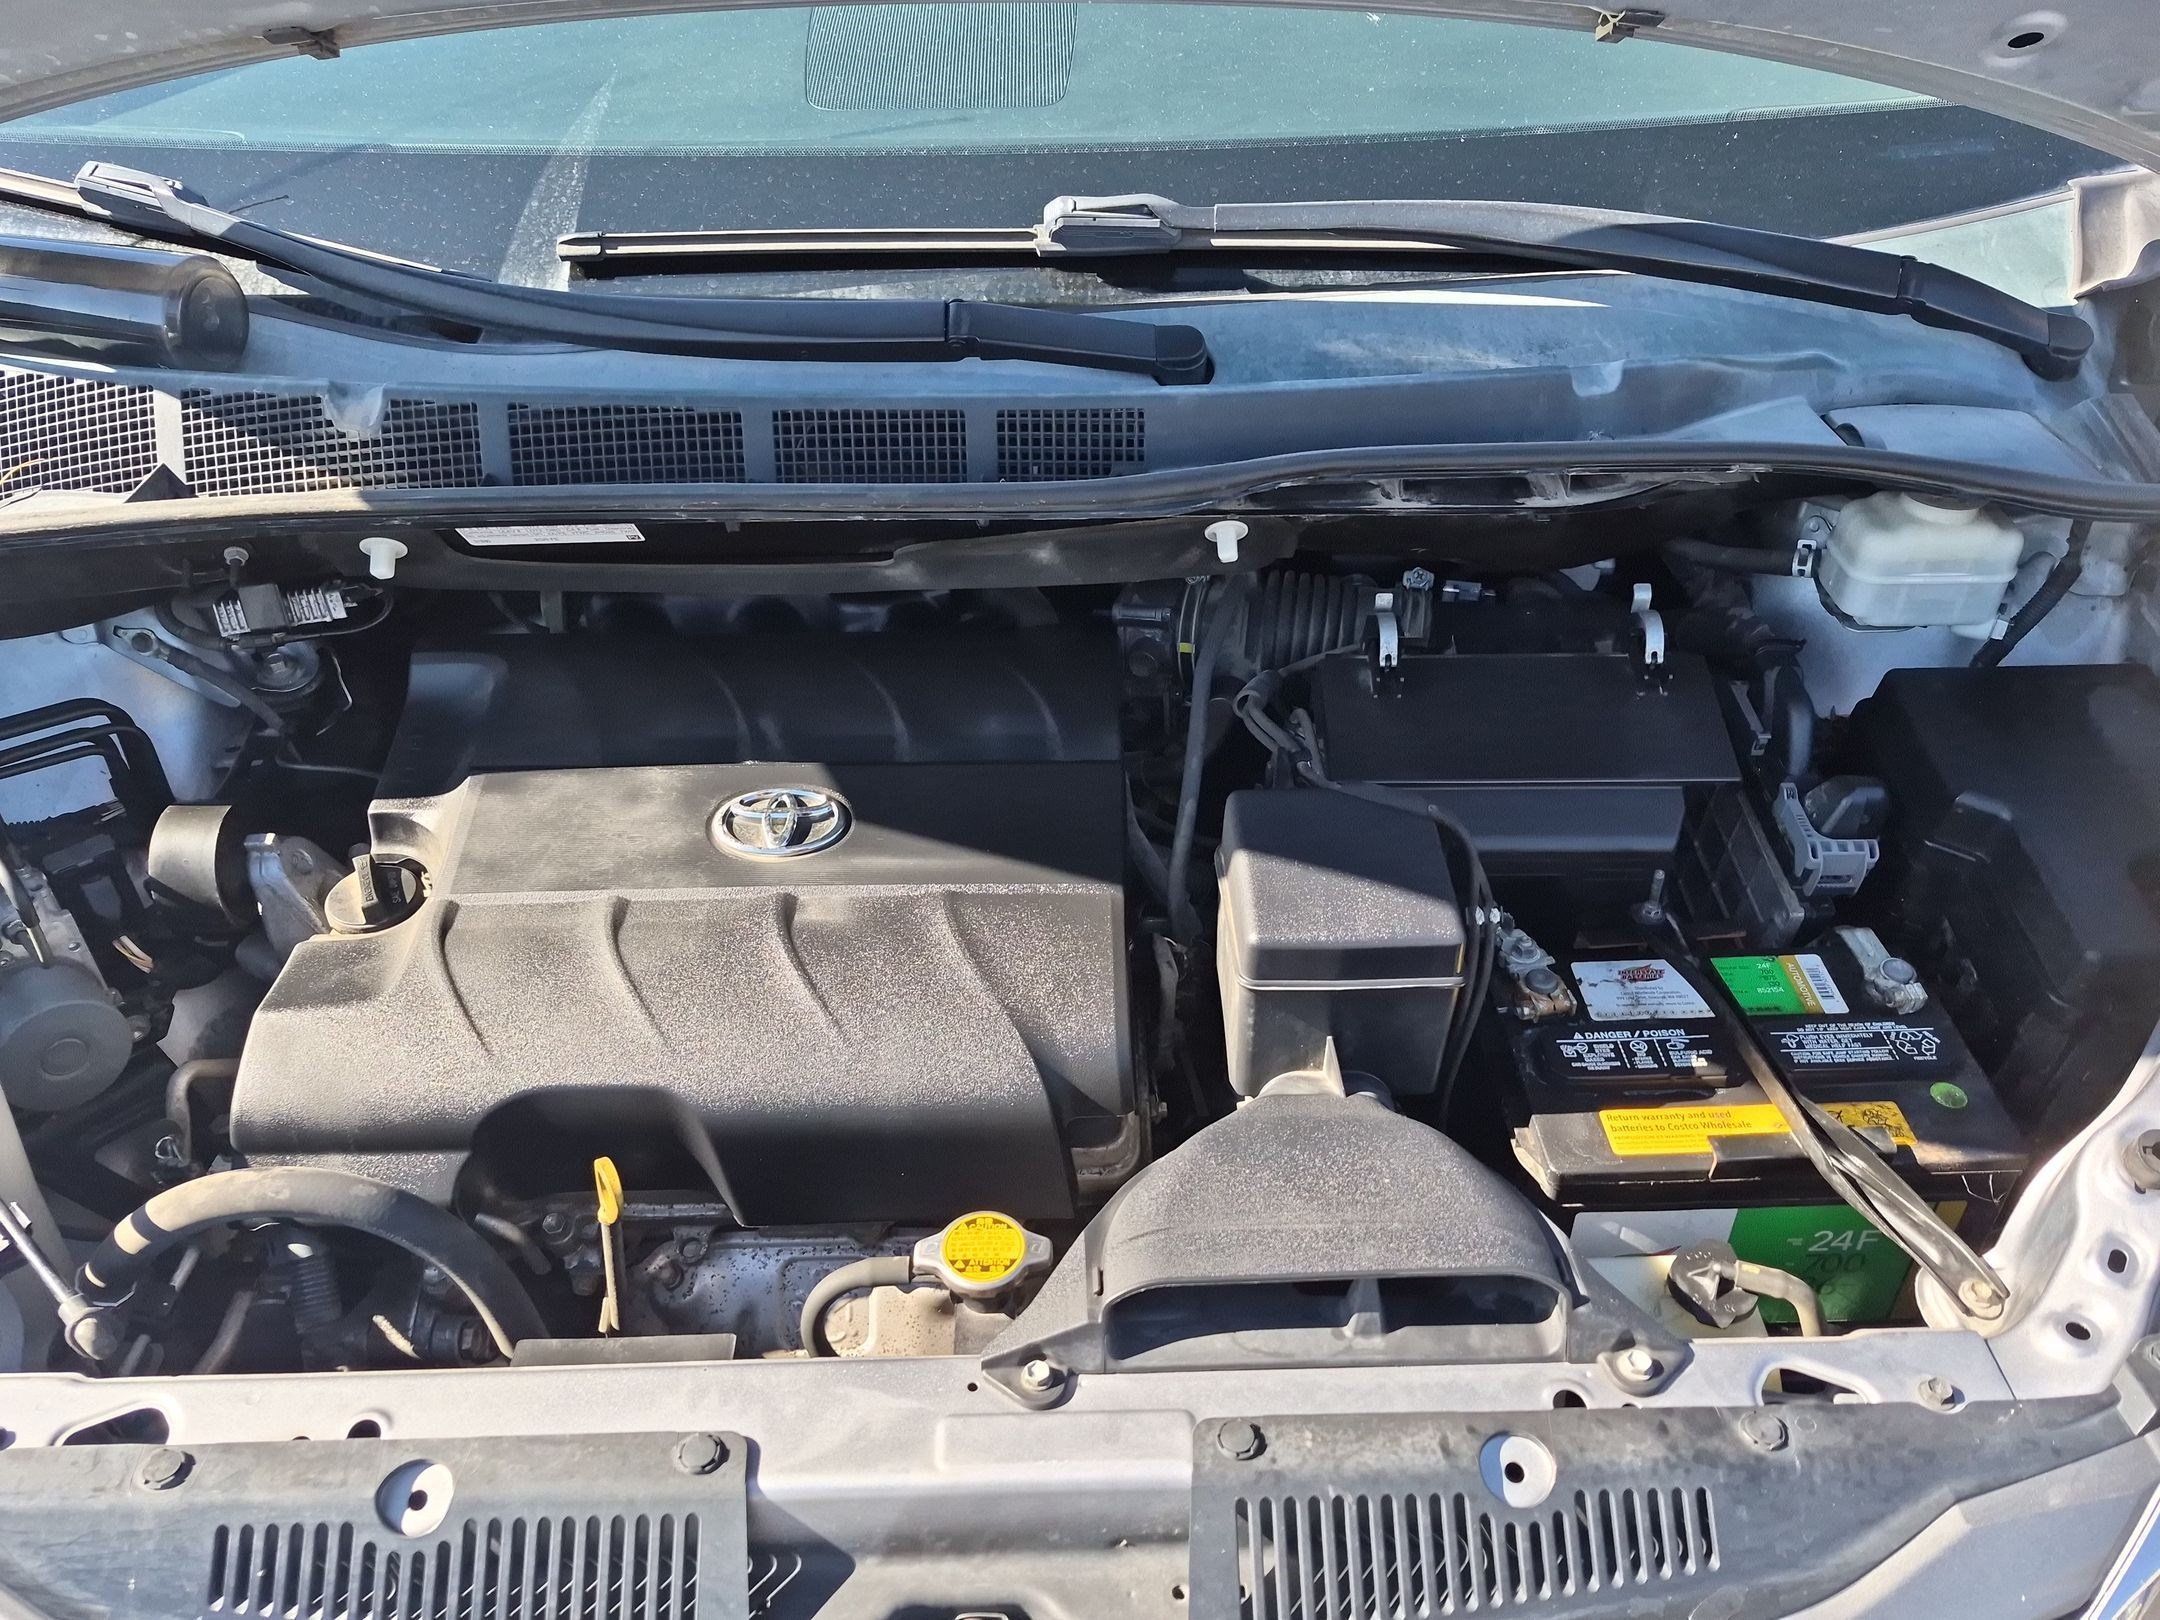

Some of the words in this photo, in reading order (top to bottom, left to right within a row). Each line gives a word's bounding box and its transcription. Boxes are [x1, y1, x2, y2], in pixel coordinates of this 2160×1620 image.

[1786, 962, 1816, 1007] AUTOMOTIVE
[1585, 1030, 1631, 1039] DANGER
[1643, 1029, 1685, 1037] POISON
[1607, 1113, 1639, 1121] Return
[1641, 1112, 1685, 1121] warranty
[1687, 1111, 1706, 1119] and
[1708, 1110, 1732, 1119] used
[1610, 1123, 1653, 1132] batteries
[1667, 1122, 1698, 1131] Costco
[1701, 1120, 1752, 1129] Wholesale
[1808, 1230, 1880, 1252] 24F
[1802, 1253, 1866, 1274] 700
